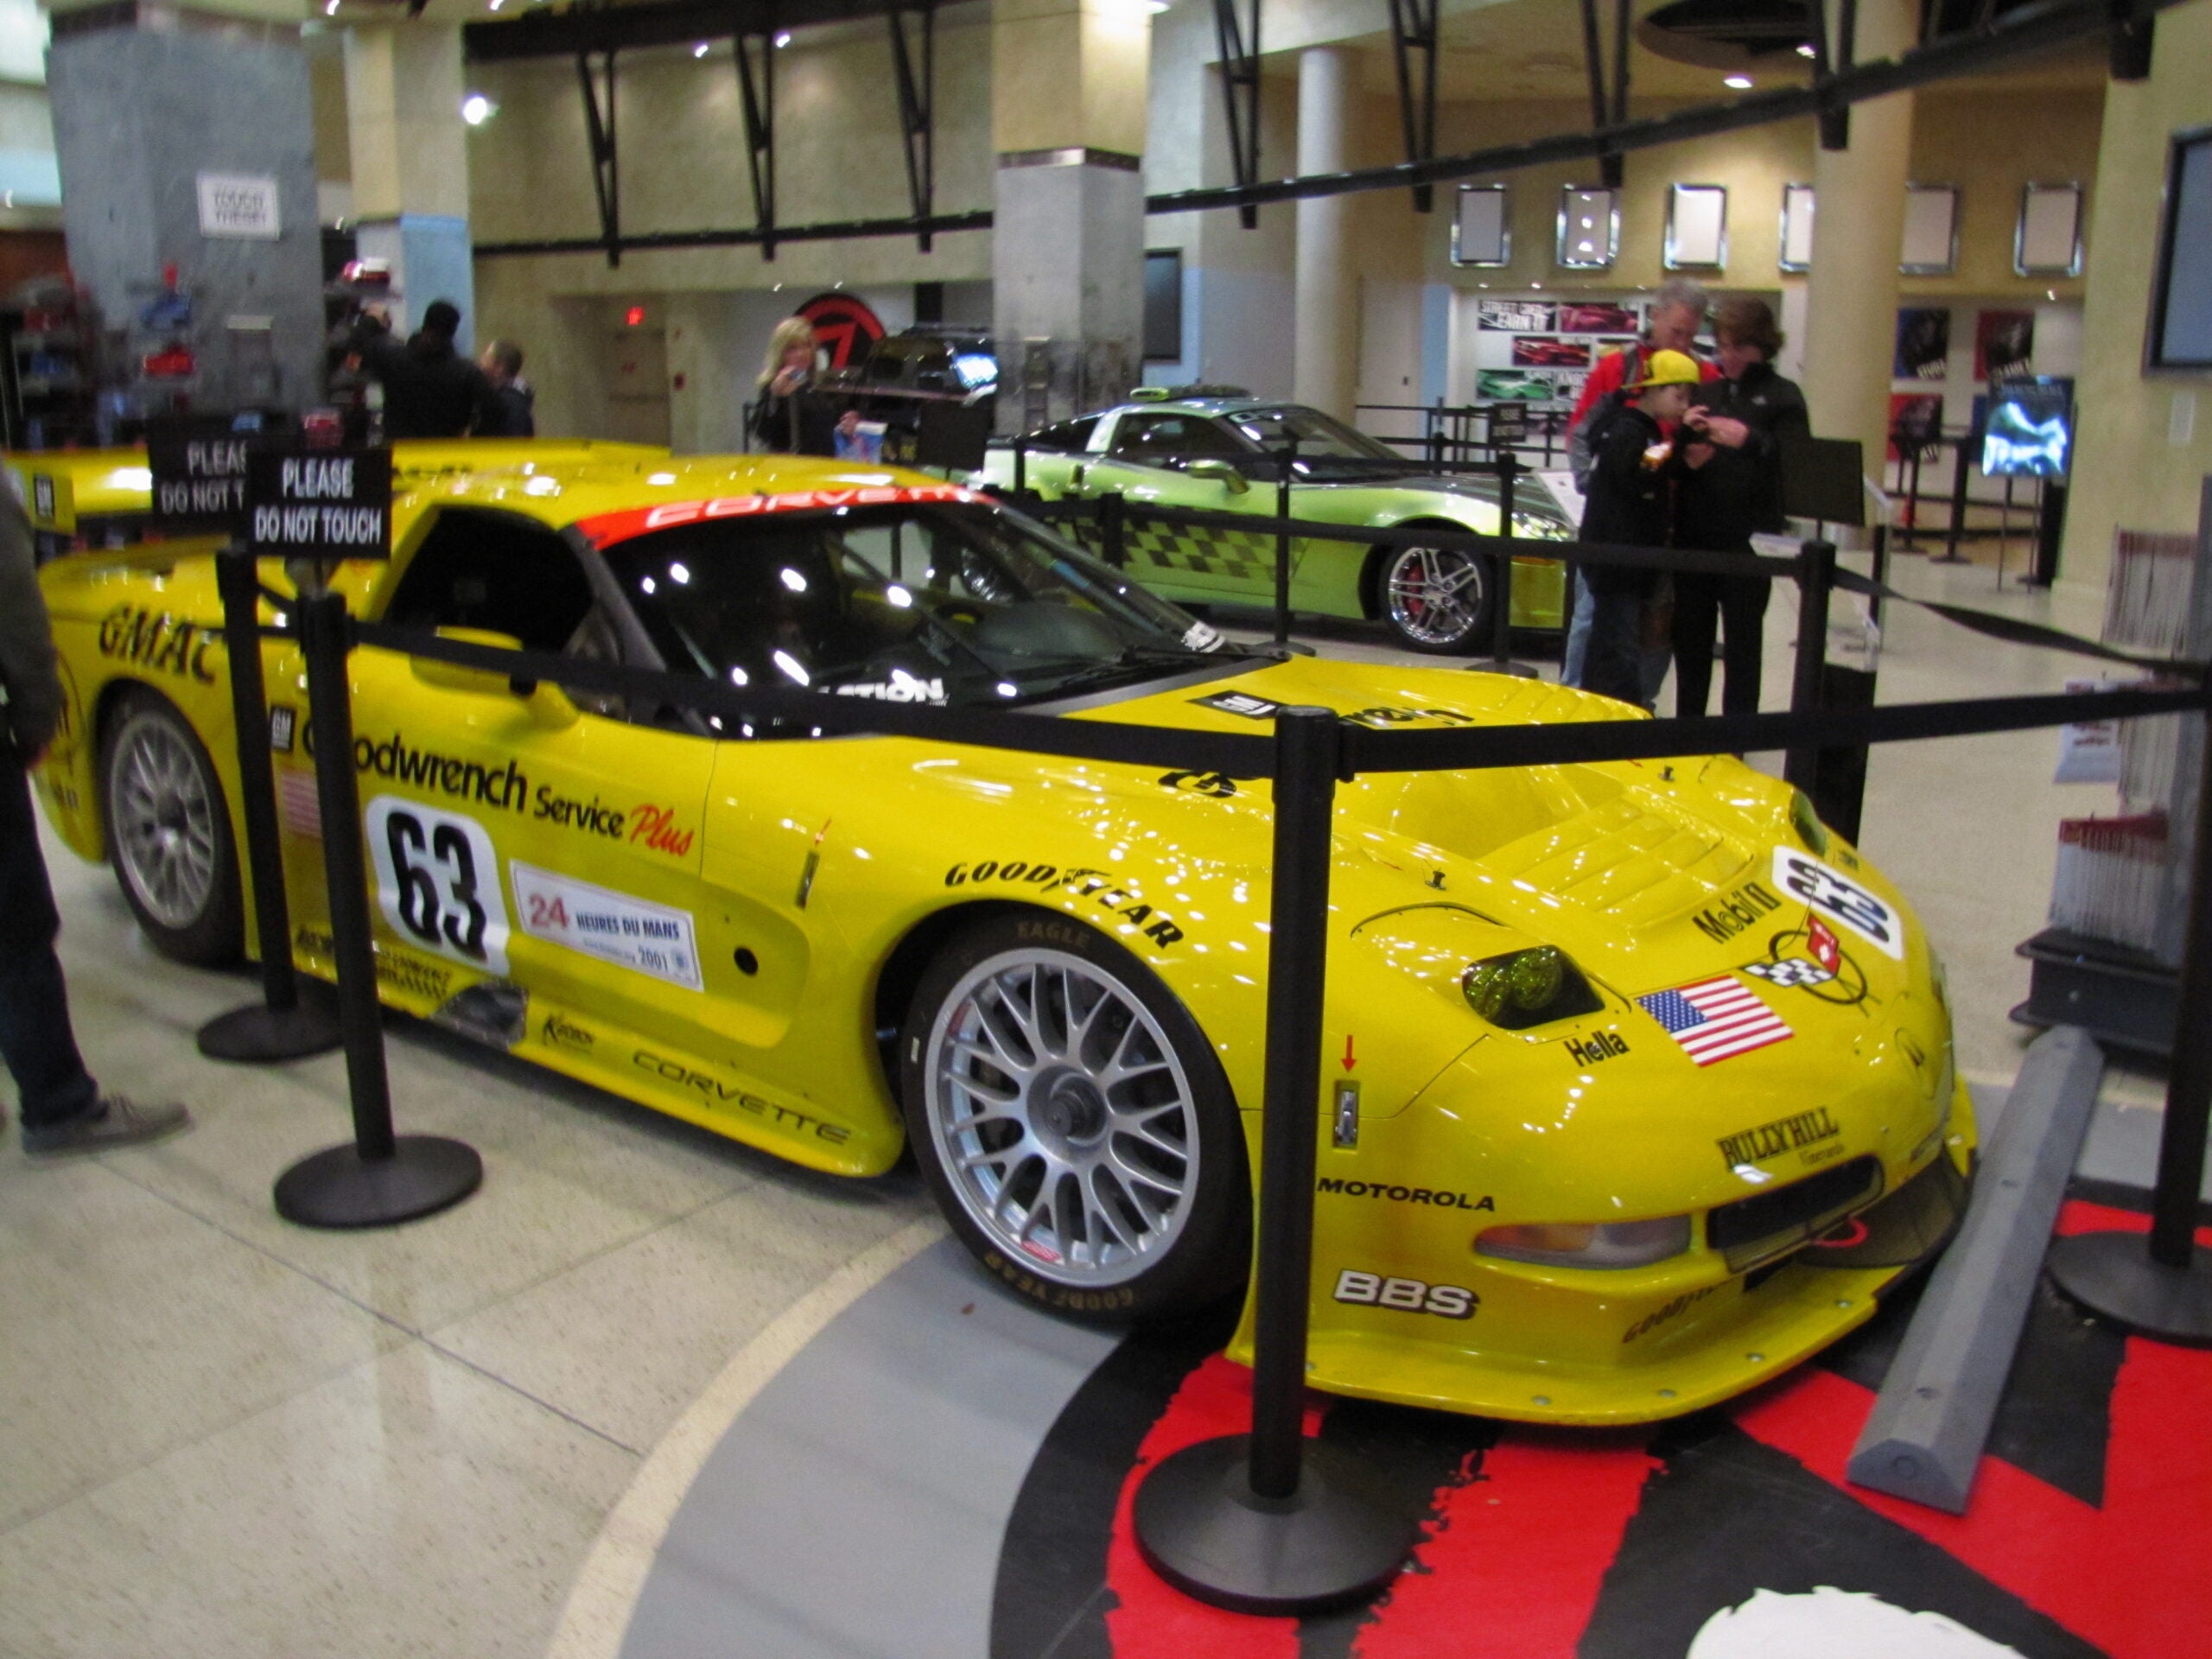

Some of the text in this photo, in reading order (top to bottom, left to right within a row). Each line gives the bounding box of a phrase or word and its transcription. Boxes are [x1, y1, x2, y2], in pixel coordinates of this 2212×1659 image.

[187, 440, 246, 476] PLEA
[282, 457, 355, 499] PLEASE
[161, 480, 188, 515] DO
[192, 477, 230, 512] NOT
[255, 505, 382, 545] DO NOT TOUCH
[99, 605, 216, 685] GMAC
[302, 717, 696, 856] odwrench Service Plus
[386, 807, 488, 964] 63
[1786, 857, 1890, 944] 63
[529, 893, 681, 942] 24 HEURES DU MANS
[1016, 920, 1090, 949] EAGLE
[1692, 887, 1764, 944] Mobil
[637, 944, 669, 973] 2001
[1563, 1030, 1630, 1068] Hella
[632, 1050, 852, 1147] CORVETTE
[1719, 1106, 1840, 1172] BULLY HILL
[1316, 1177, 1496, 1212] MOTOROLA
[1333, 1269, 1480, 1320] BBS
